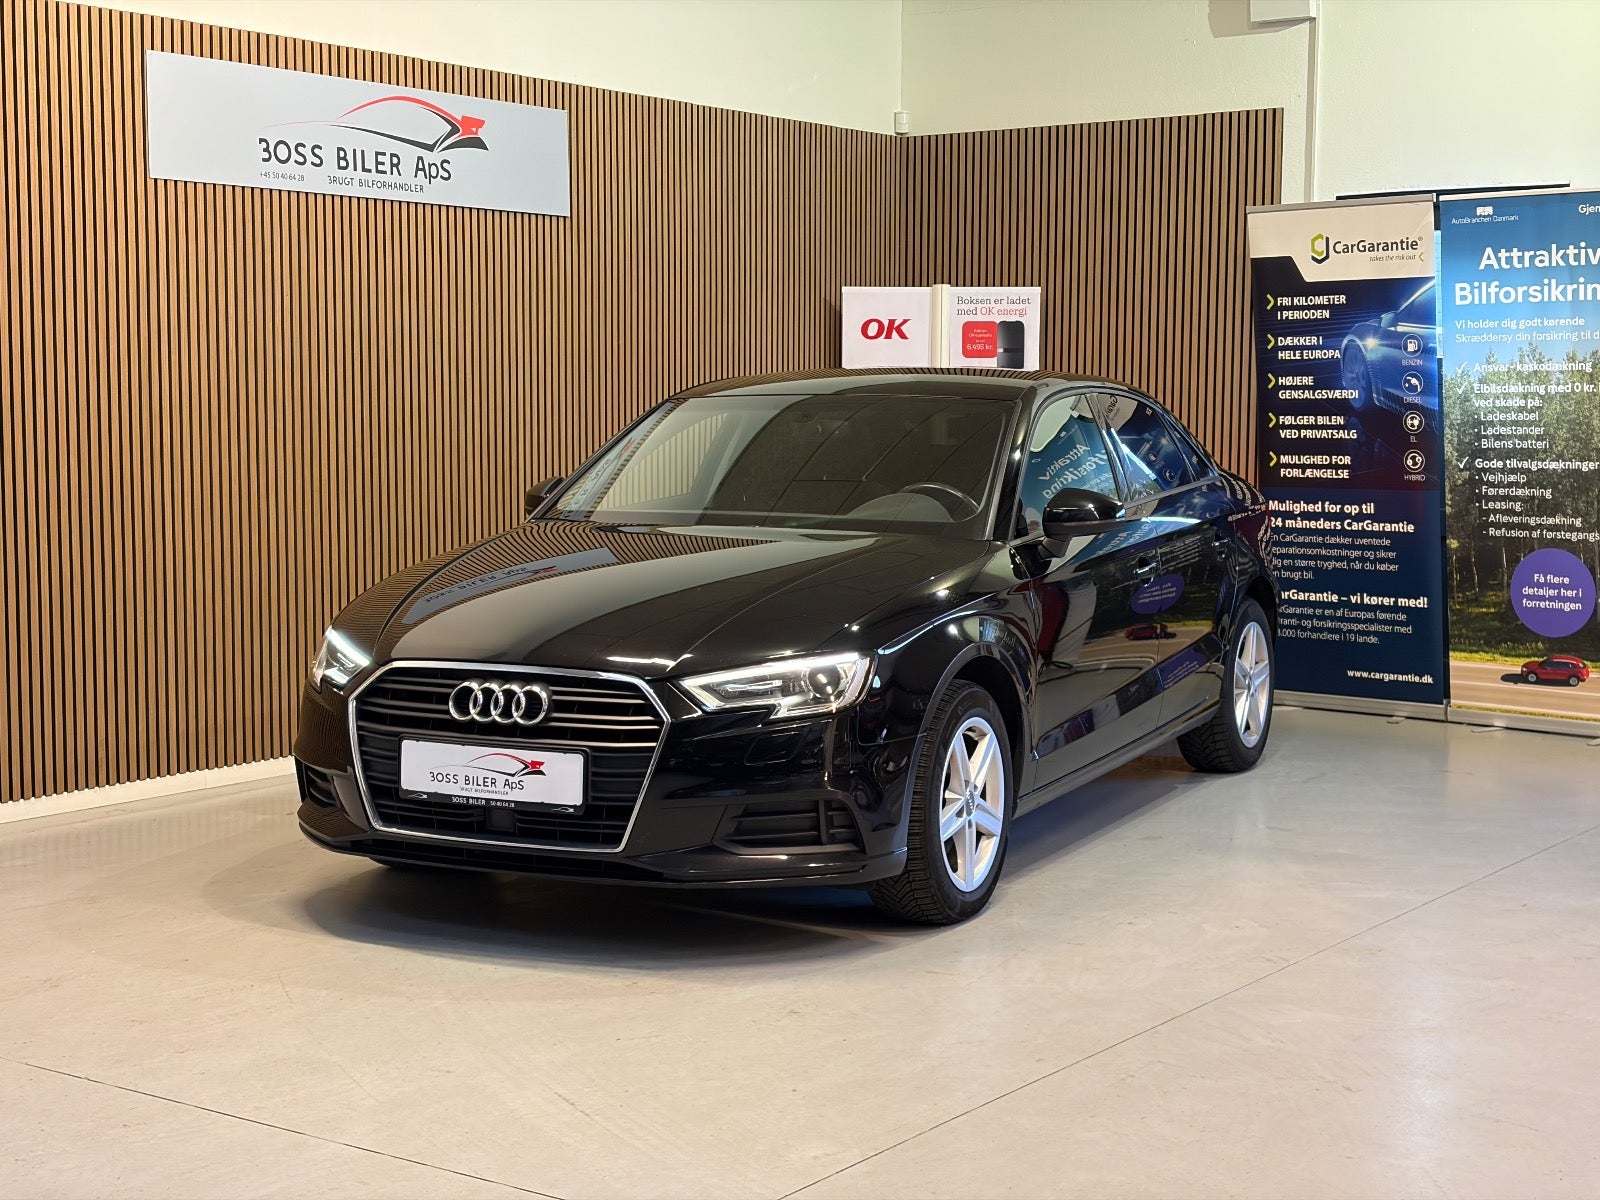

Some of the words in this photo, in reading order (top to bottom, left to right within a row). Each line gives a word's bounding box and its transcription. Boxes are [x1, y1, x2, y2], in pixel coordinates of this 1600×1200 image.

[336, 146, 402, 177] BILER
[413, 155, 452, 185] ApS
[260, 171, 271, 179] +45
[272, 171, 280, 180] 50
[280, 172, 288, 180] 40
[288, 173, 297, 181] 64
[297, 174, 305, 182] 28
[358, 178, 424, 194] BILFORHANDLER
[956, 295, 992, 305] Boksen
[993, 297, 1005, 305] er
[1006, 295, 1031, 305] ladet
[1277, 297, 1292, 307] FRI
[1293, 294, 1346, 306] KILOMETER
[956, 307, 978, 316] med
[979, 307, 995, 316] OK
[996, 308, 1028, 318] energi
[1277, 310, 1281, 320] I
[1282, 309, 1330, 319] PERIODEN
[1455, 319, 1466, 329] Vi
[1467, 318, 1500, 328] holder
[1501, 317, 1518, 329] dig
[1518, 317, 1543, 329] godt
[1543, 316, 1586, 327] kørende
[860, 318, 911, 341] OK
[1277, 337, 1317, 346] DÆKKER
[1455, 332, 1513, 344] Skræddersy
[1515, 331, 1531, 341] din
[1532, 329, 1579, 342] forsikring
[1580, 329, 1592, 340] til
[1277, 349, 1302, 360] HELE
[1303, 348, 1341, 360] EUROPA
[1401, 358, 1423, 367] BENZIN
[1516, 361, 1593, 374] kaskodækning
[1278, 376, 1315, 386] HØJERE
[1473, 383, 1546, 395] Elbilsdækning
[1547, 382, 1572, 394] med
[1573, 382, 1582, 393] 0
[1583, 382, 1597, 393] kr.
[1278, 390, 1359, 400] GENSALGSVÆRDI
[1403, 396, 1423, 404] DIESEL
[1473, 399, 1493, 408] ved
[1494, 398, 1526, 407] skade
[1527, 398, 1544, 409] på:
[1279, 415, 1316, 426] FØLGER
[1317, 416, 1345, 426] BILEN
[1480, 411, 1540, 422] Ladeskabel
[1279, 429, 1300, 440] VED
[1300, 429, 1358, 440] PRIVATSALG
[1480, 425, 1546, 436] Ladestander
[1410, 436, 1419, 444] EL
[1481, 439, 1514, 449] Bilens
[1515, 439, 1550, 449] batteri
[1280, 454, 1331, 465] MULIGHED
[1331, 454, 1352, 465] FOR
[1475, 458, 1504, 468] Gode
[1505, 457, 1600, 471] tilvalgsdækninger
[1280, 468, 1350, 479] FORLÆNGELSE
[1403, 474, 1427, 483] HYBRID
[1481, 472, 1527, 485] Vejhjælp
[1481, 486, 1553, 499] Førerdækning
[1268, 500, 1322, 515] Mulighed
[1324, 501, 1342, 513] for
[1343, 504, 1360, 516] op
[1360, 502, 1375, 514] til
[1285, 516, 1342, 530] måneders
[1343, 520, 1415, 533] CarGarantie
[1488, 514, 1582, 528] Afleveringsdækning
[1489, 528, 1530, 538] Refusion
[1531, 529, 1541, 539] af
[1279, 533, 1323, 544] CarGarantie
[1324, 535, 1352, 545] dækker
[1354, 537, 1391, 547] uventede
[1271, 546, 1362, 559] eparationsomkostninger
[1363, 551, 1375, 560] og
[1376, 550, 1397, 559] sikrer
[1294, 559, 1316, 568] større
[1317, 560, 1349, 571] tryghed,
[1350, 561, 1363, 570] når
[1363, 561, 1375, 571] du
[1376, 561, 1399, 572] køber
[1281, 569, 1303, 581] brugt
[1533, 573, 1545, 583] Få
[1546, 574, 1570, 584] flere
[1522, 587, 1559, 598] detaljer
[1560, 587, 1578, 597] her
[1350, 592, 1361, 603] vi
[1363, 592, 1395, 606] kører
[1397, 596, 1428, 609] med!
[1522, 599, 1582, 612] forretningen
[1324, 609, 1335, 617] en
[1335, 608, 1344, 617] af
[1344, 608, 1376, 620] Europas
[1376, 610, 1407, 621] førende
[1301, 619, 1312, 629] og
[1312, 618, 1393, 633] forsikringsspecialister
[1394, 624, 1413, 634] med
[1297, 630, 1340, 641] forhandlere
[1345, 633, 1355, 642] 19
[1356, 633, 1380, 645] lande.
[1347, 669, 1434, 685] www.cargarantie.dk
[464, 774, 498, 789] BILER
[503, 779, 525, 792] ApS
[468, 798, 486, 806] BILER
